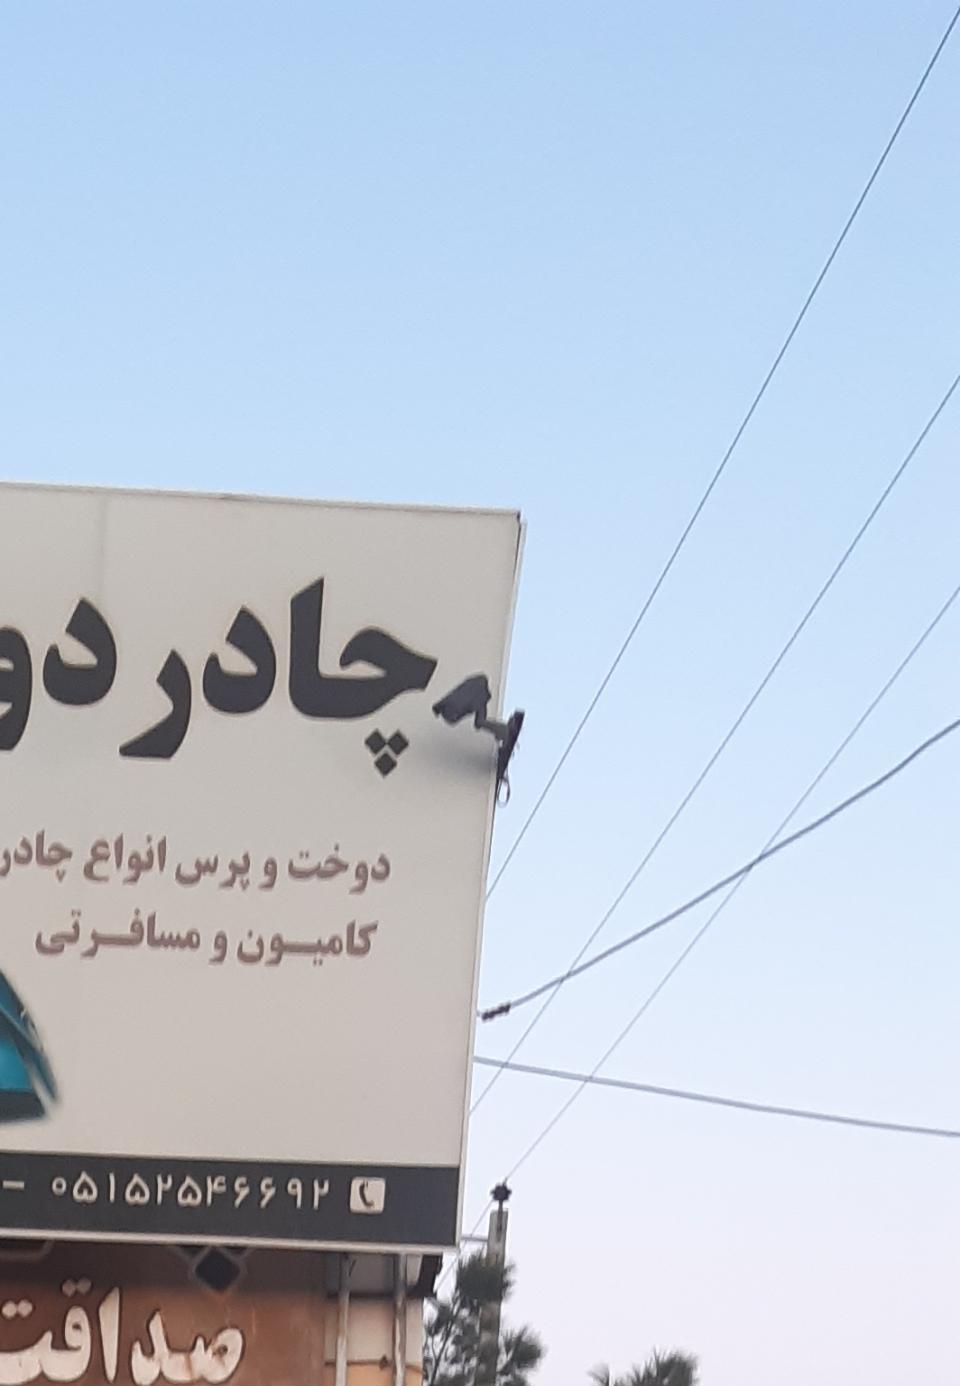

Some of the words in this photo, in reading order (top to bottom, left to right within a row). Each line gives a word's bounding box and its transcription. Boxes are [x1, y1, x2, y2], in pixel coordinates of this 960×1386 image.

[82, 832, 167, 887] انواع
[174, 851, 251, 892] پرس
[258, 856, 279, 891] و
[287, 843, 391, 895] دوخت
[34, 907, 201, 959] مسافرتی
[208, 930, 228, 965] و
[236, 919, 379, 967] کامیون
